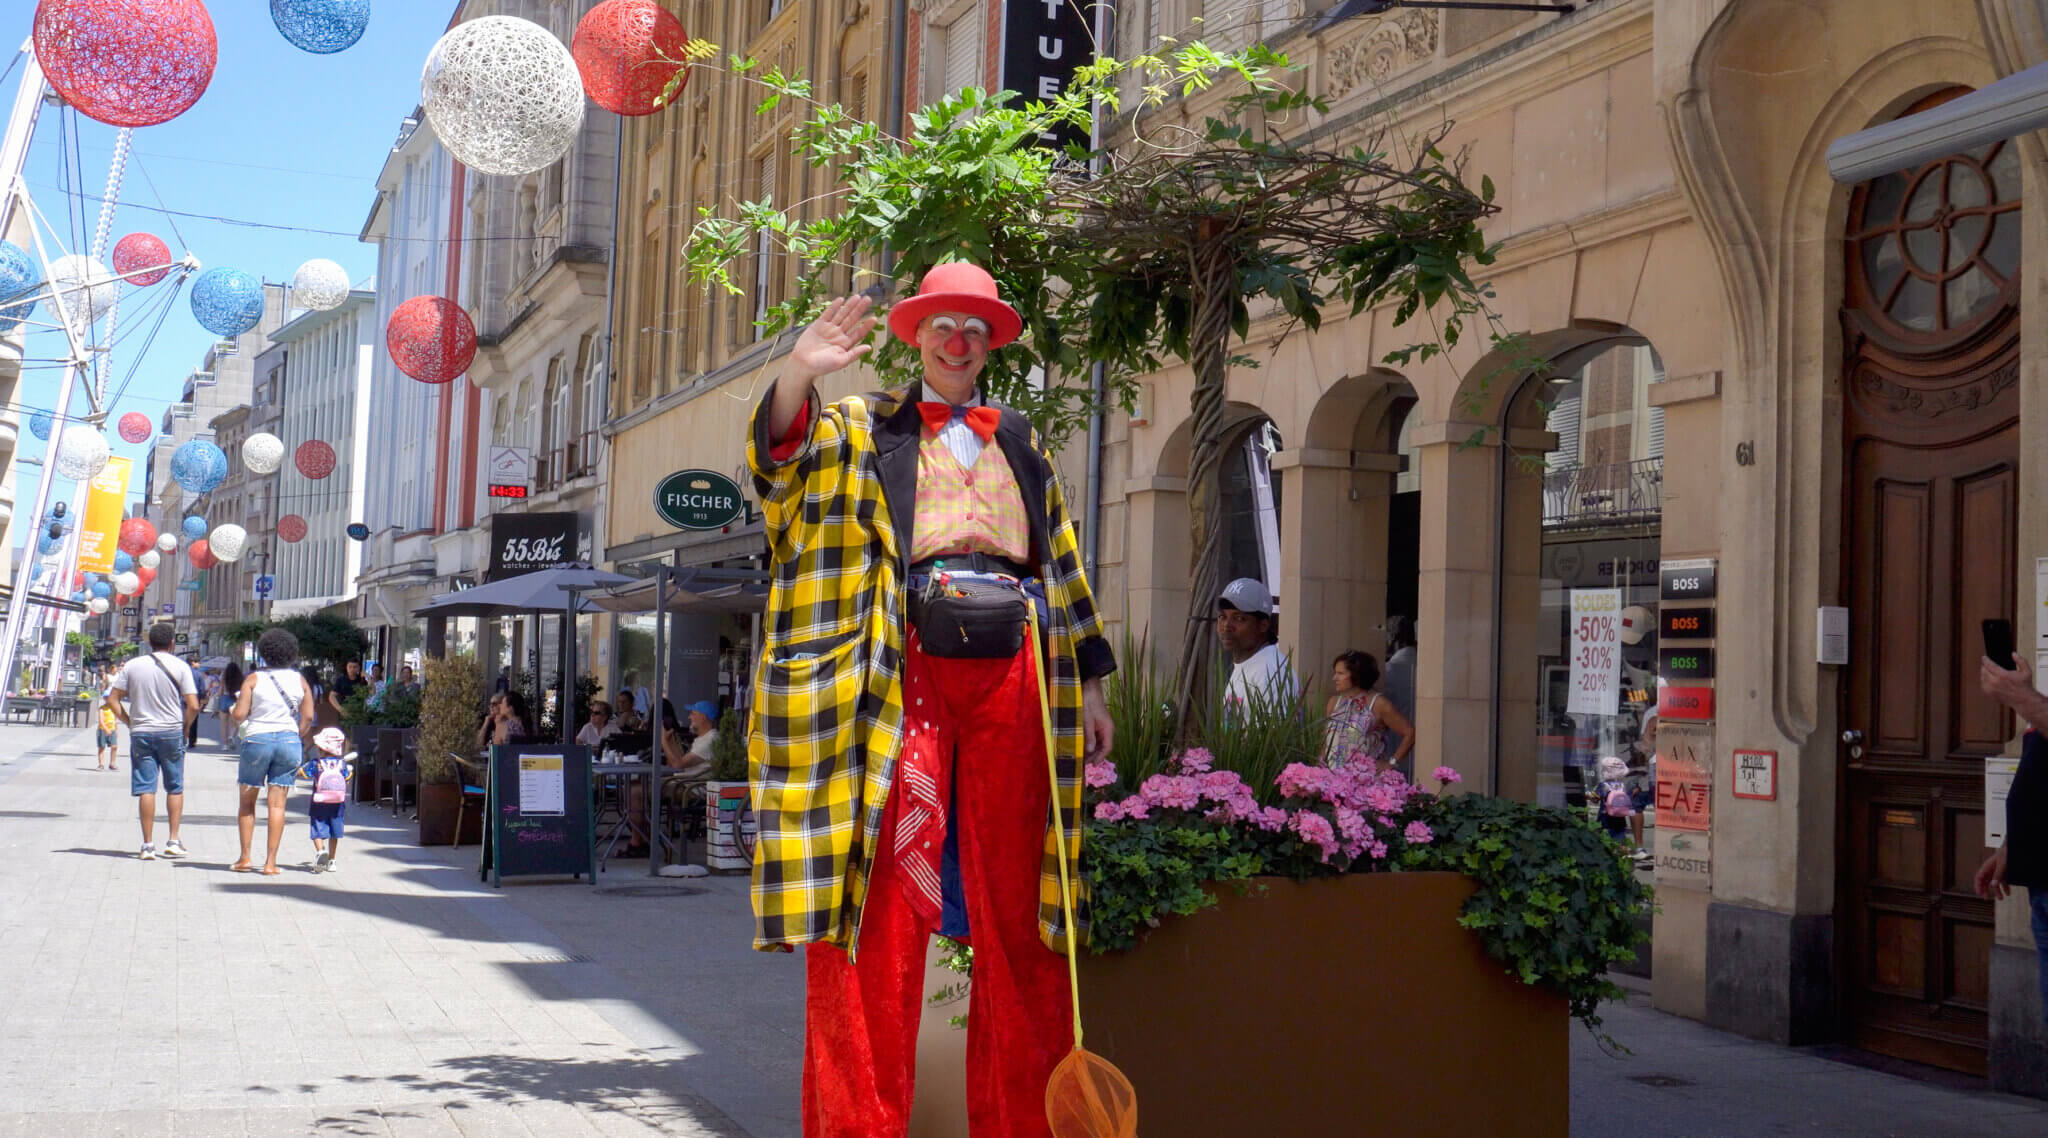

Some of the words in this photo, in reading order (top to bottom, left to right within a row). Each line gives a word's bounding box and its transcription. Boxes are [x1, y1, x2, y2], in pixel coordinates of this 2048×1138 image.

[1037, 0, 1065, 141] TUE
[1736, 440, 1756, 466] 61
[490, 485, 526, 498] 14:33
[667, 493, 733, 510] FISCHER
[1672, 578, 1699, 590] BOSS
[1574, 594, 1616, 612] SOLDES
[1671, 617, 1699, 630] BOSS
[1671, 657, 1698, 668] BOSS
[1669, 695, 1699, 708] HUGO
[1657, 781, 1708, 813] EA7
[1655, 855, 1707, 874] LACOSTE
